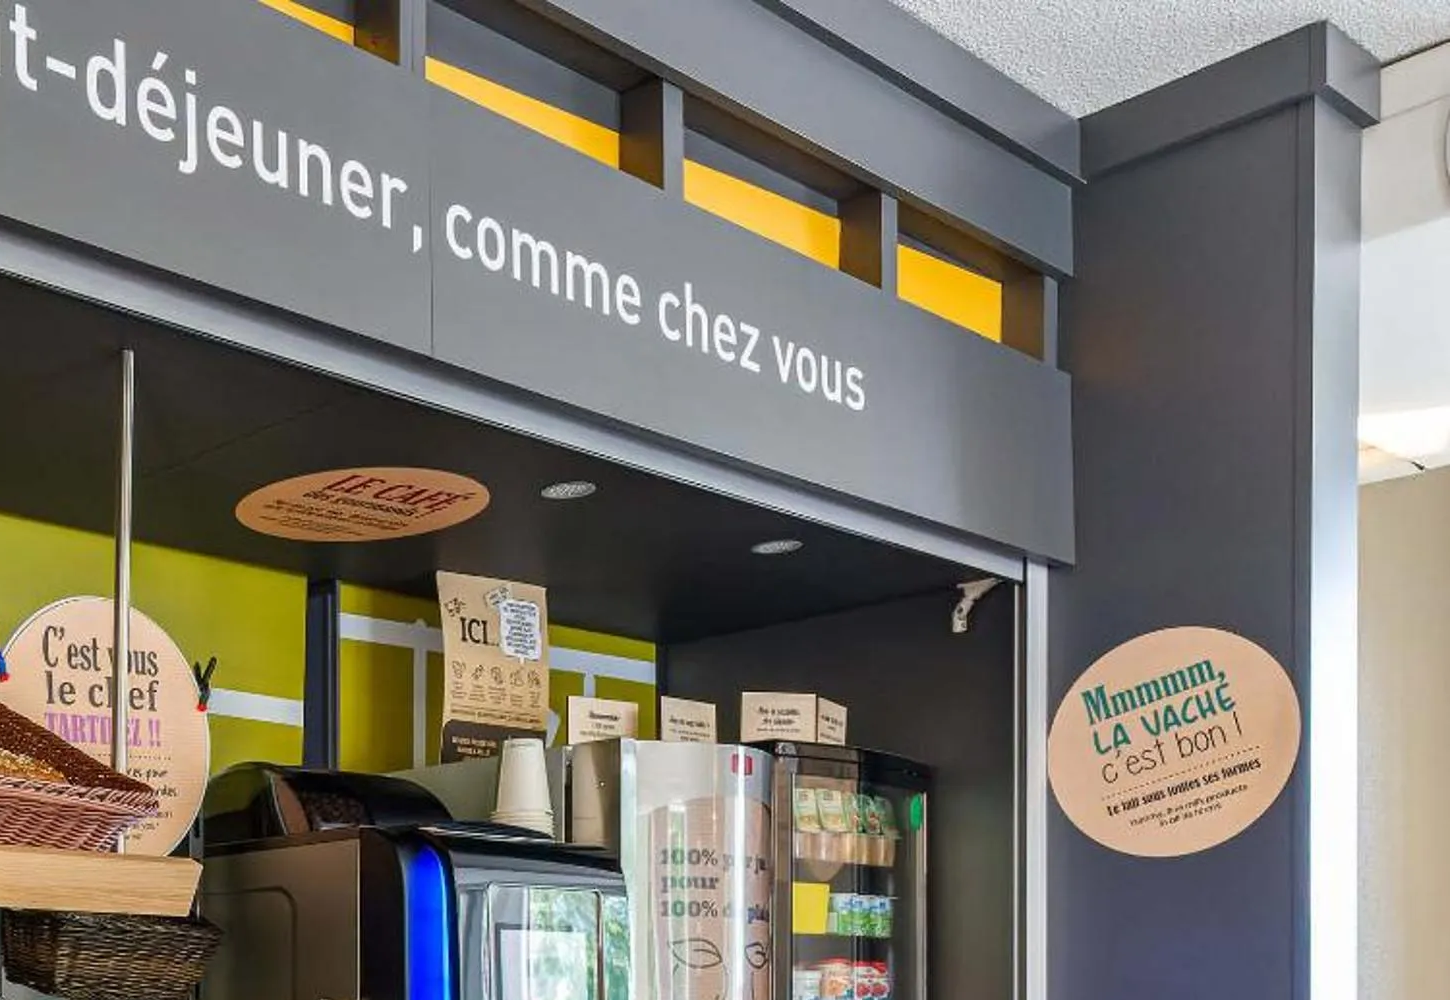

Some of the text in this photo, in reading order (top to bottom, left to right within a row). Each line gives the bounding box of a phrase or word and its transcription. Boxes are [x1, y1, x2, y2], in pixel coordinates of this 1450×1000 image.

[445, 203, 642, 326] comme
[657, 282, 762, 373] chez
[772, 335, 867, 411] vous
[322, 474, 387, 494] LE
[42, 625, 100, 671] C'est
[45, 671, 77, 706] le
[44, 711, 143, 747] TARTIZ
[1093, 682, 1237, 755] LA VACHE
[1102, 738, 1166, 784] c'est
[1175, 724, 1227, 758] bon
[1202, 772, 1221, 784] ses
[660, 848, 719, 867] 100%
[661, 900, 719, 918] 100%
